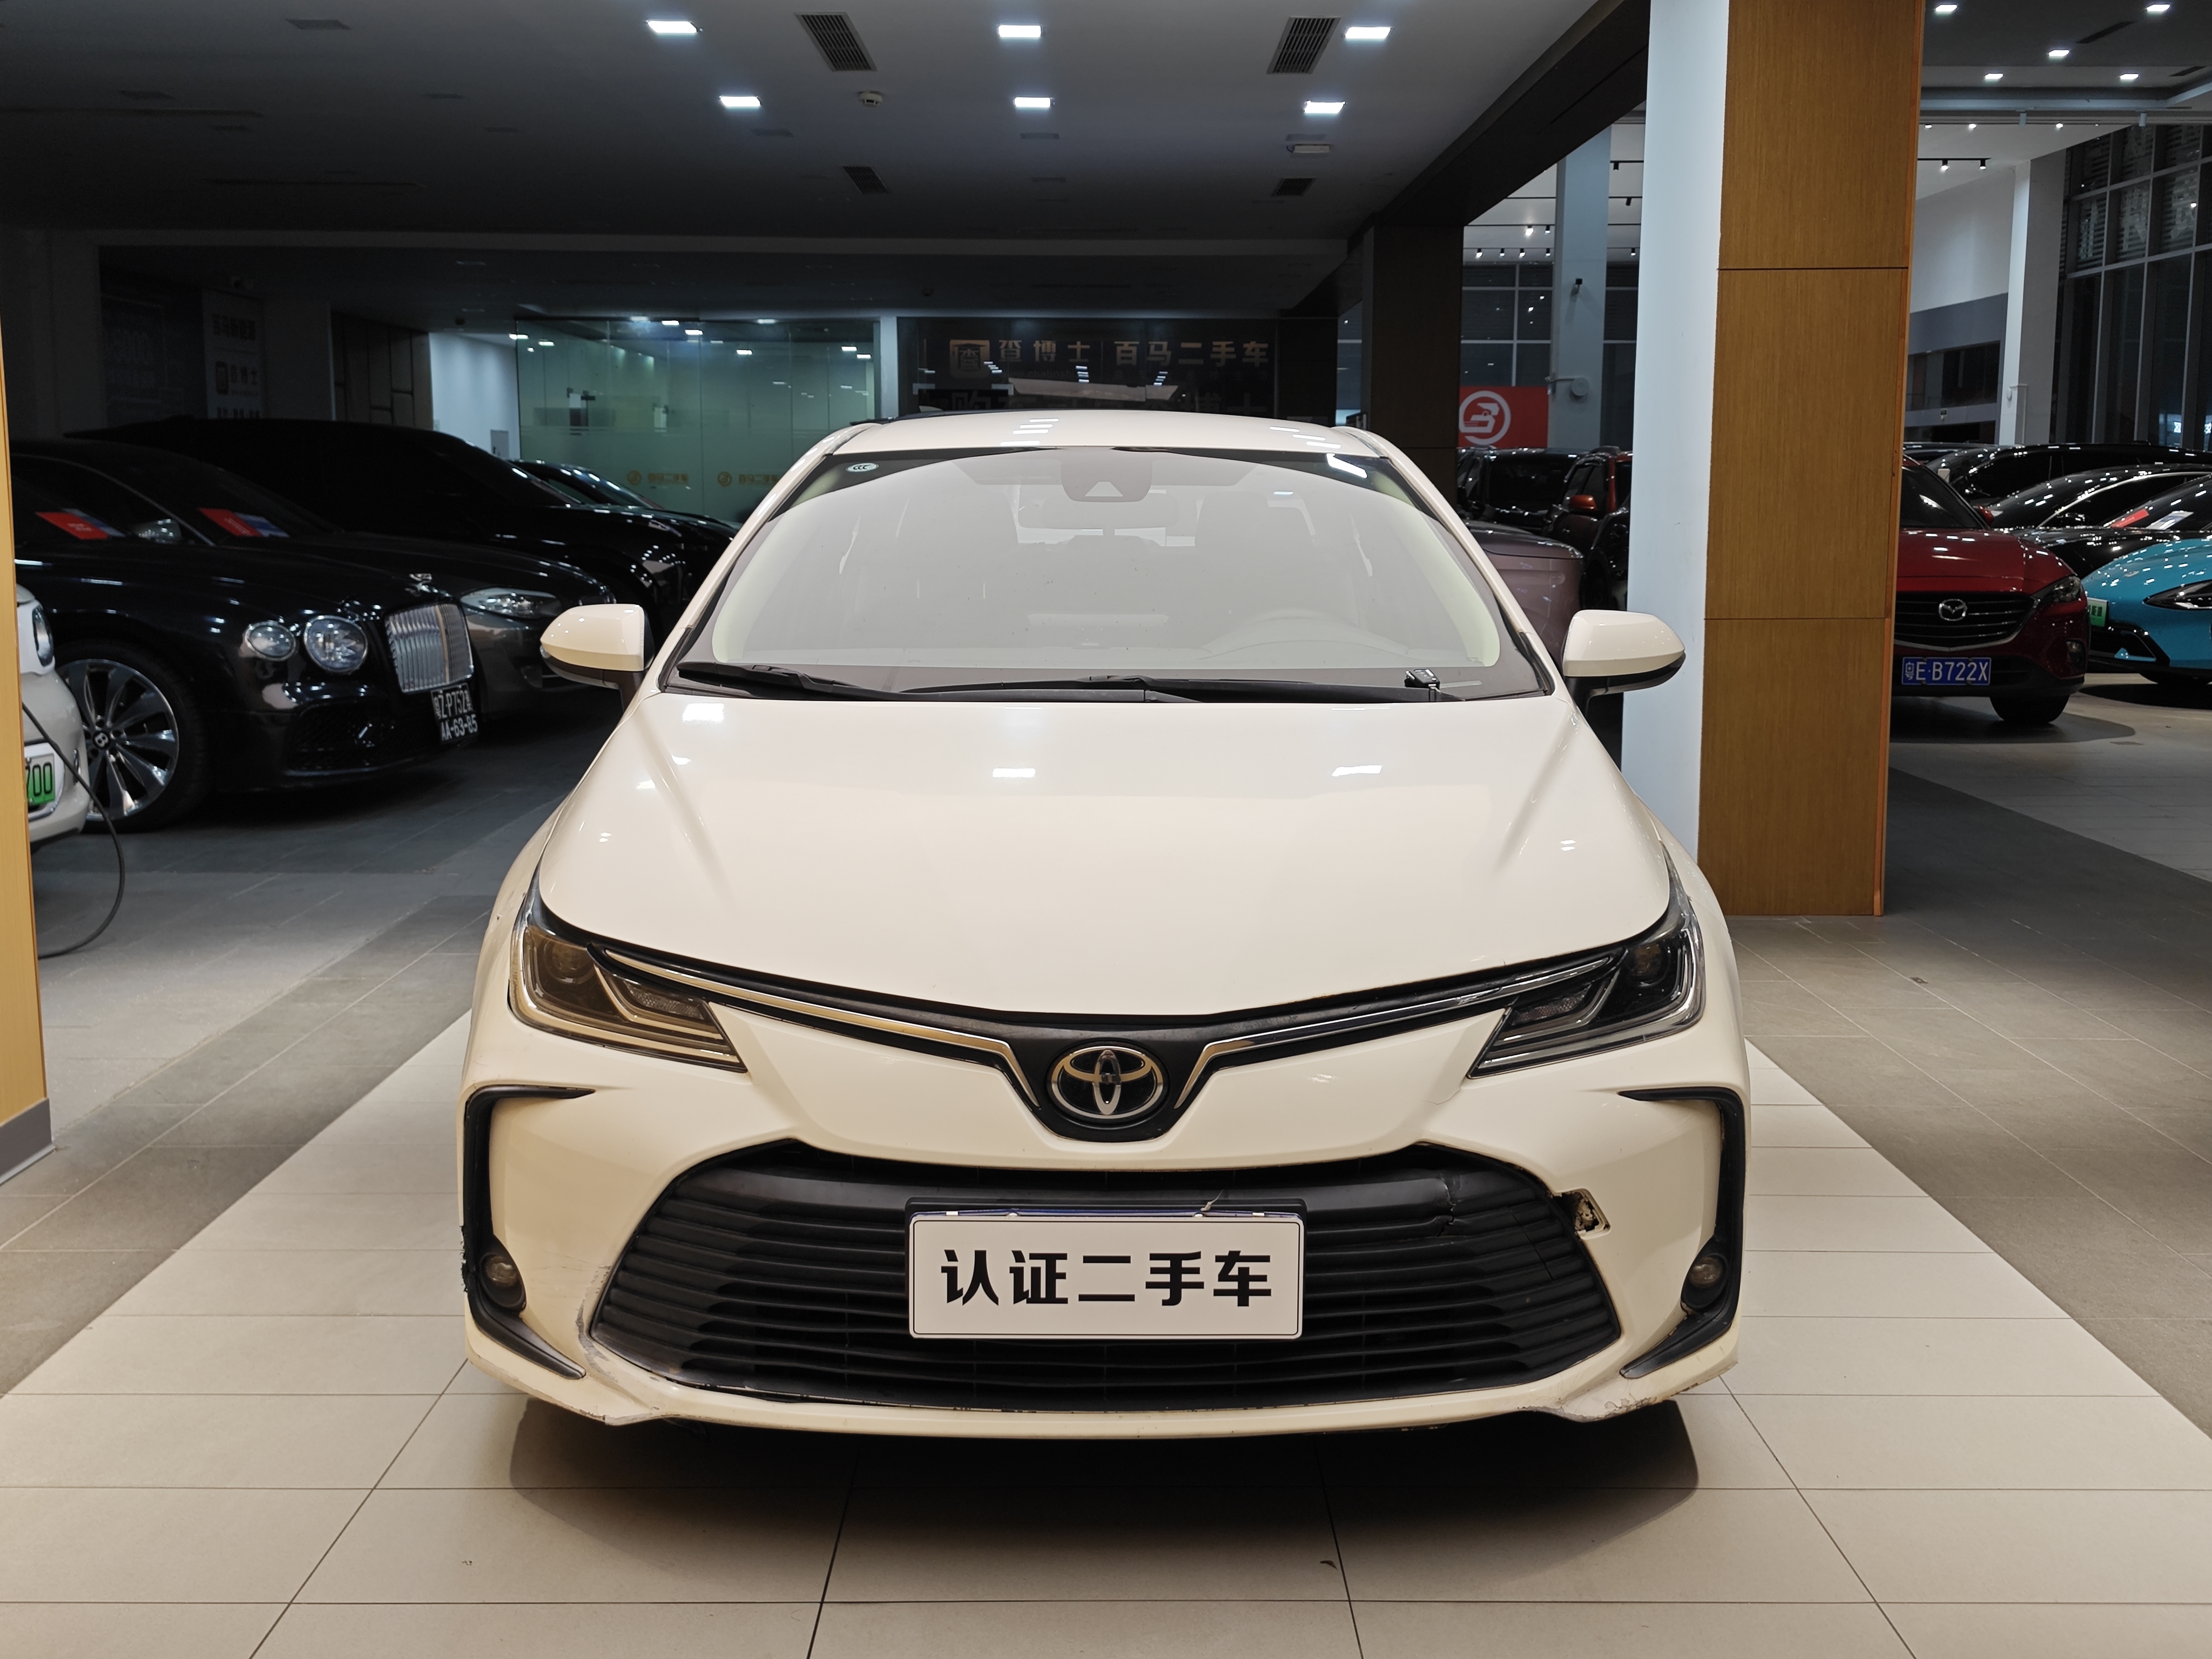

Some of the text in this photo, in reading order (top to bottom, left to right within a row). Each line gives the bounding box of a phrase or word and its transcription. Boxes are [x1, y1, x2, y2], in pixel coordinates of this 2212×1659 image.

[999, 340, 1269, 367] 查博士 百马二手车
[441, 714, 477, 741] AA-63-85
[941, 1249, 1271, 1307] 认证二手车
